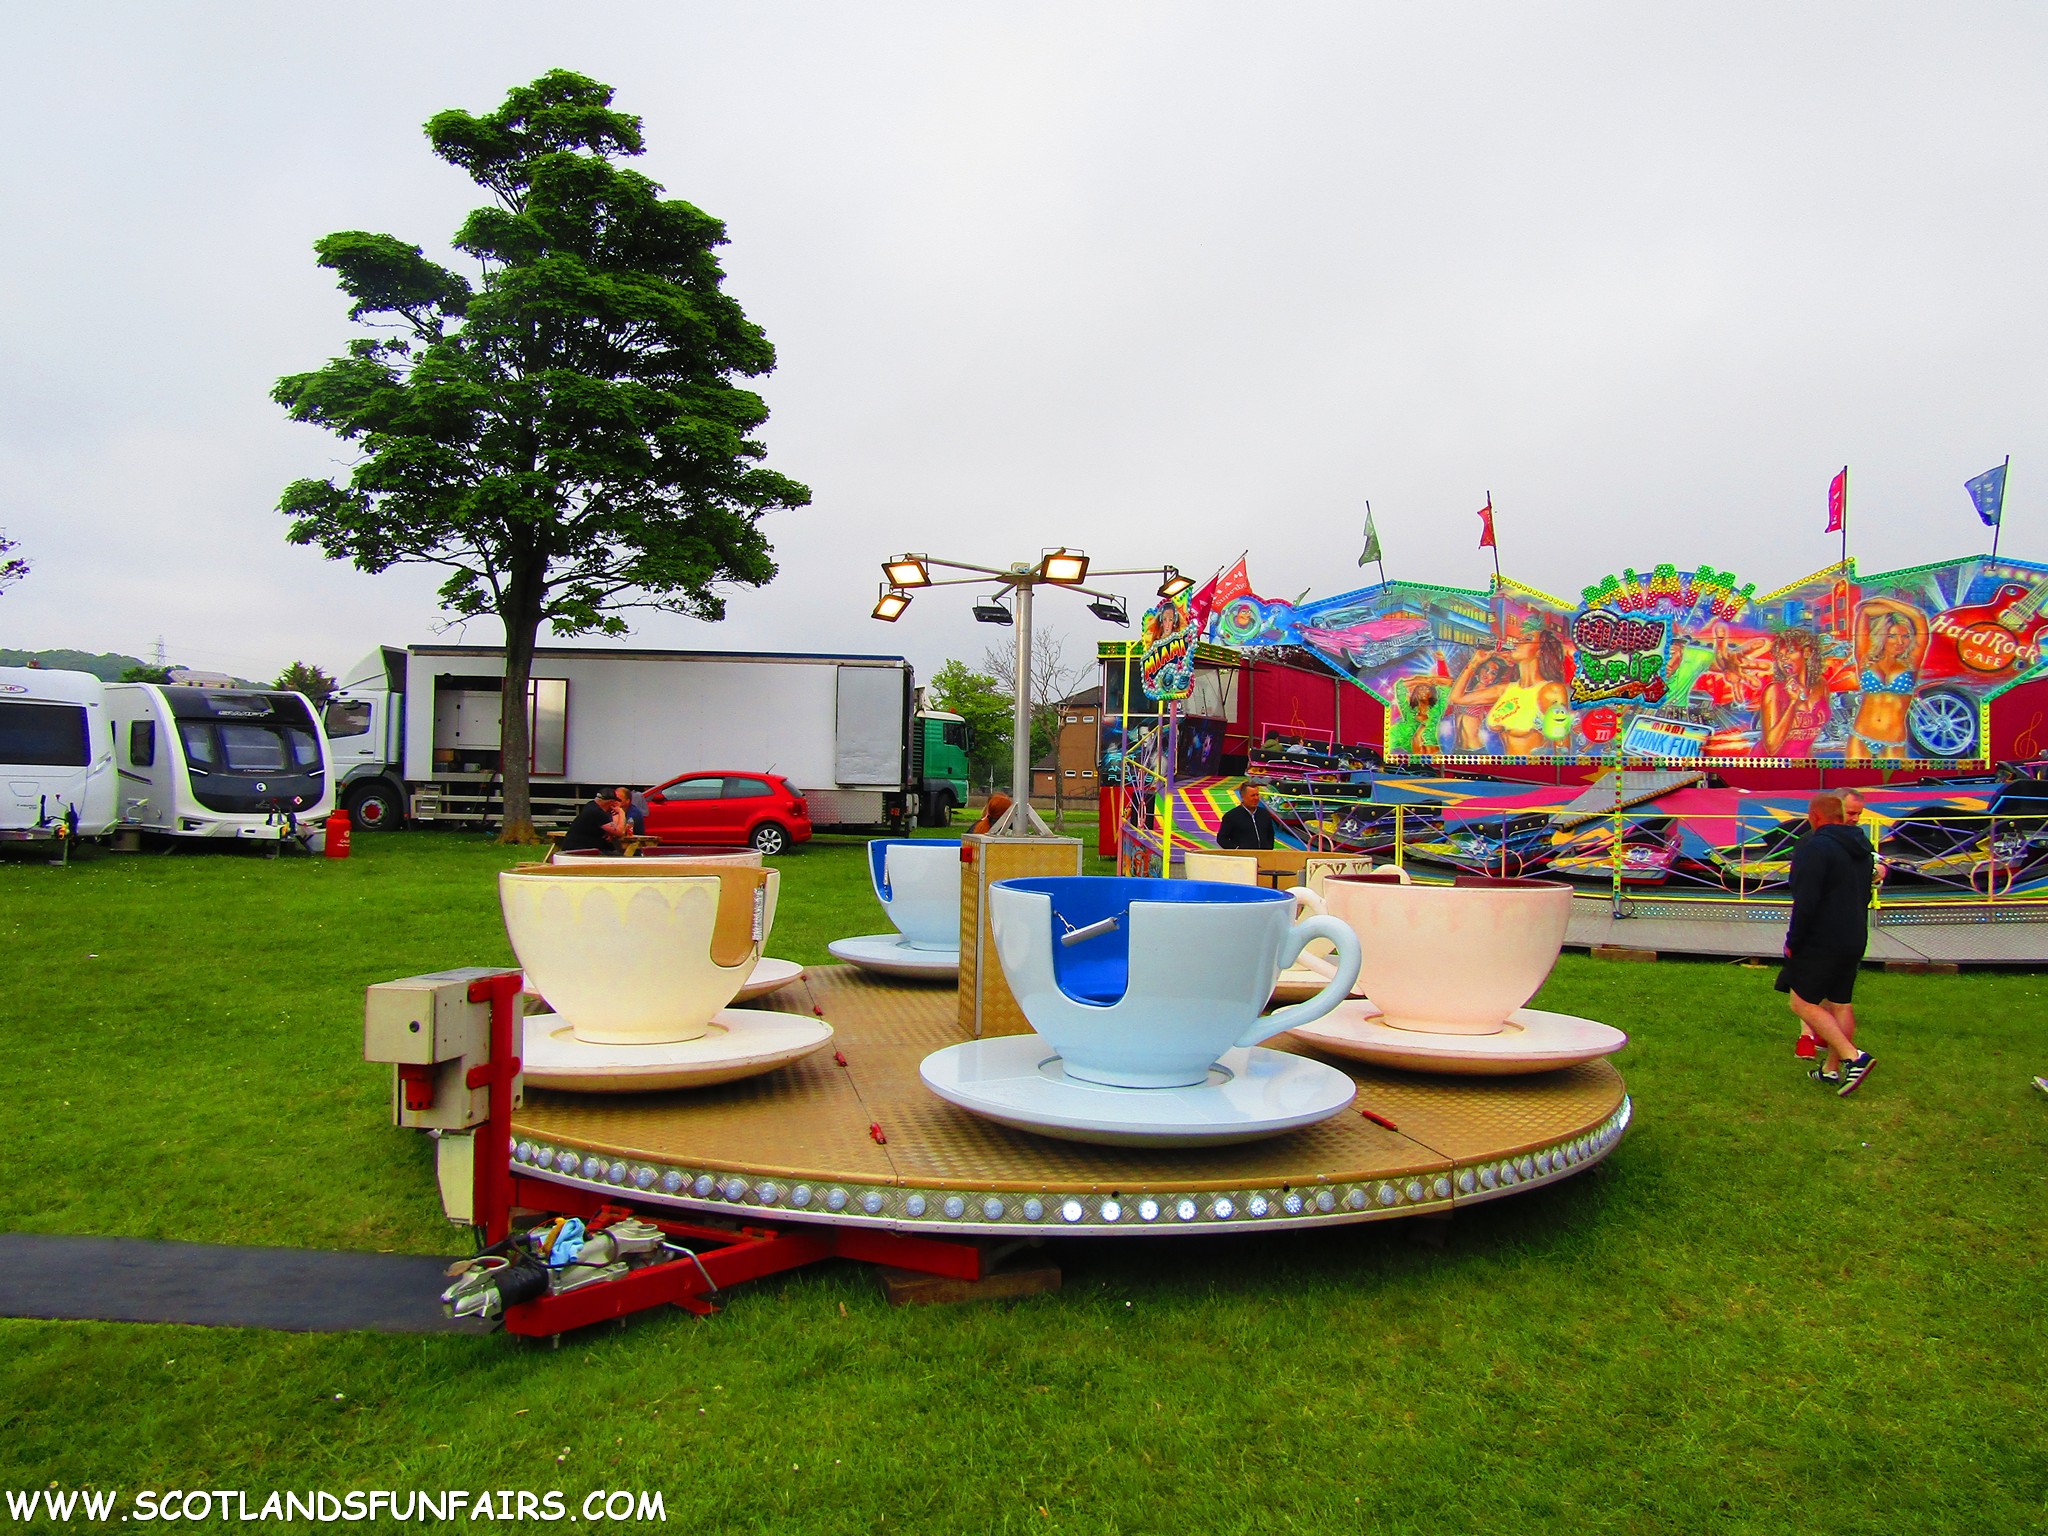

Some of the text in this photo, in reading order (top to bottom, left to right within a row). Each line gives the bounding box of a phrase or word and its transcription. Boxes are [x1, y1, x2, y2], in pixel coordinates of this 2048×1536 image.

[1581, 563, 1756, 621] MIAMI
[1929, 615, 2039, 664] Hard Rock
[1144, 638, 1187, 681] MIAMI
[1963, 649, 2002, 667] CAFE
[1630, 729, 1703, 757] THINK FUN
[1651, 722, 1686, 735] MIAMI
